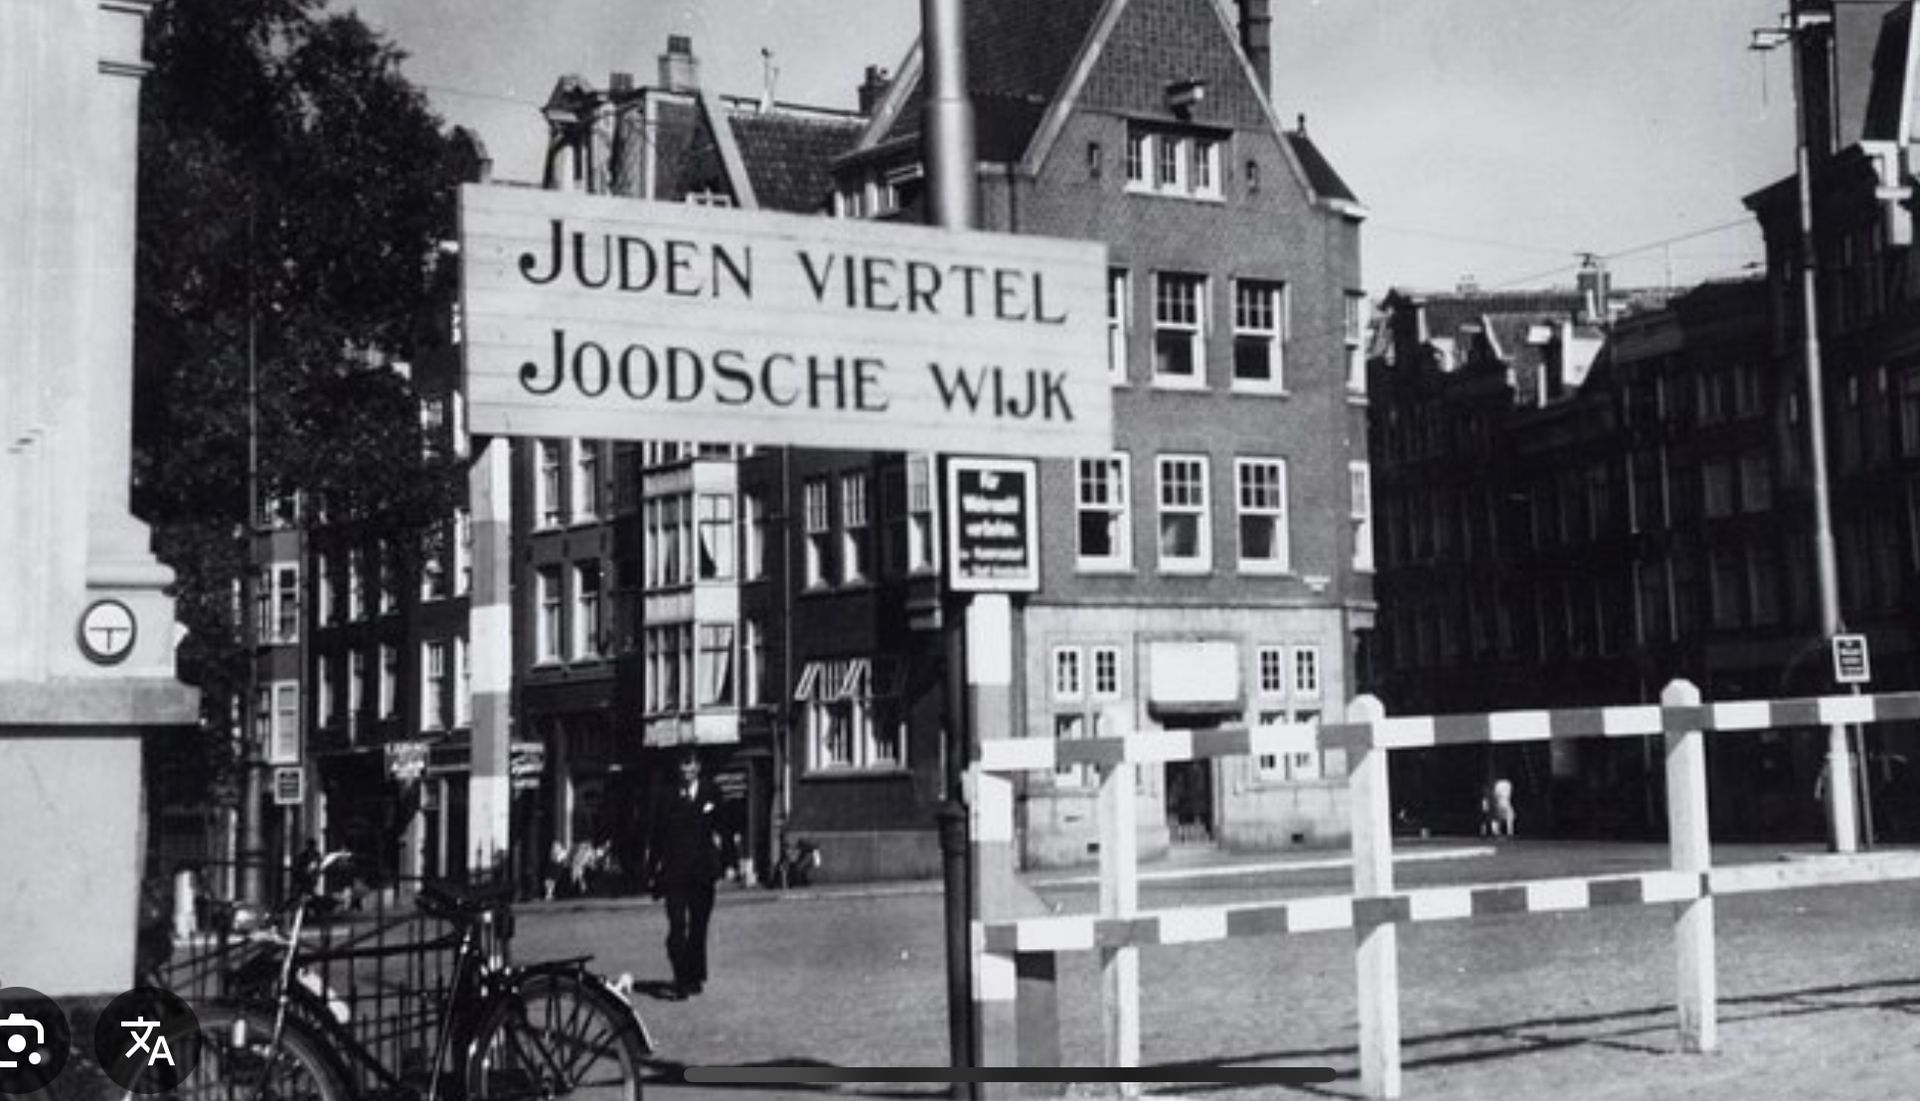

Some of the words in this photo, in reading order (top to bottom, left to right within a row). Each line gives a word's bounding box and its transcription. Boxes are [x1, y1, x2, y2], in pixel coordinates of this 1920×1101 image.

[518, 219, 752, 299] JUDEN
[798, 251, 1068, 325] VIERTEL
[518, 329, 889, 413] JOODSCHE
[929, 362, 1075, 422] WIJK
